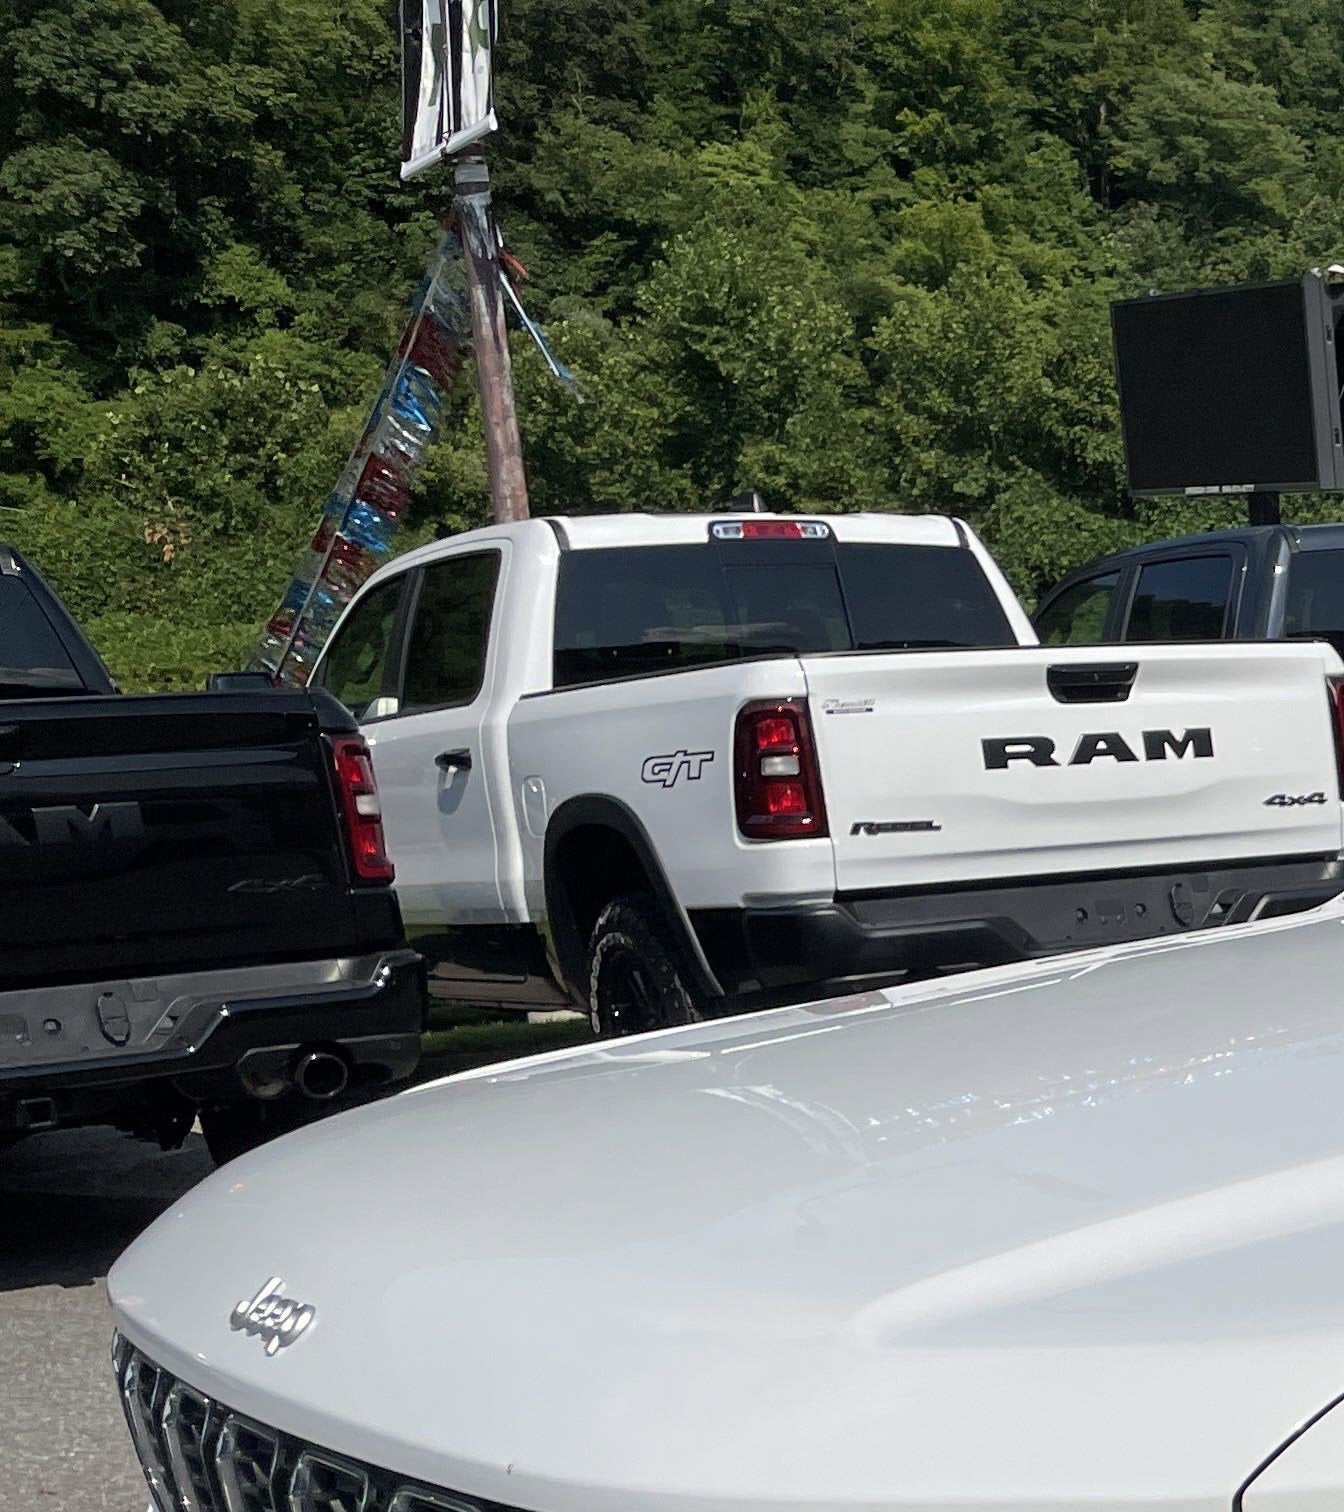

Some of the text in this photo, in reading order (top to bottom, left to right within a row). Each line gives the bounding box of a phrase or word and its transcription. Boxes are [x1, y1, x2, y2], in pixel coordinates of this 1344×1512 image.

[981, 728, 1214, 770] RAM
[1262, 792, 1328, 806] 4x4
[230, 1276, 317, 1357] Jeep
